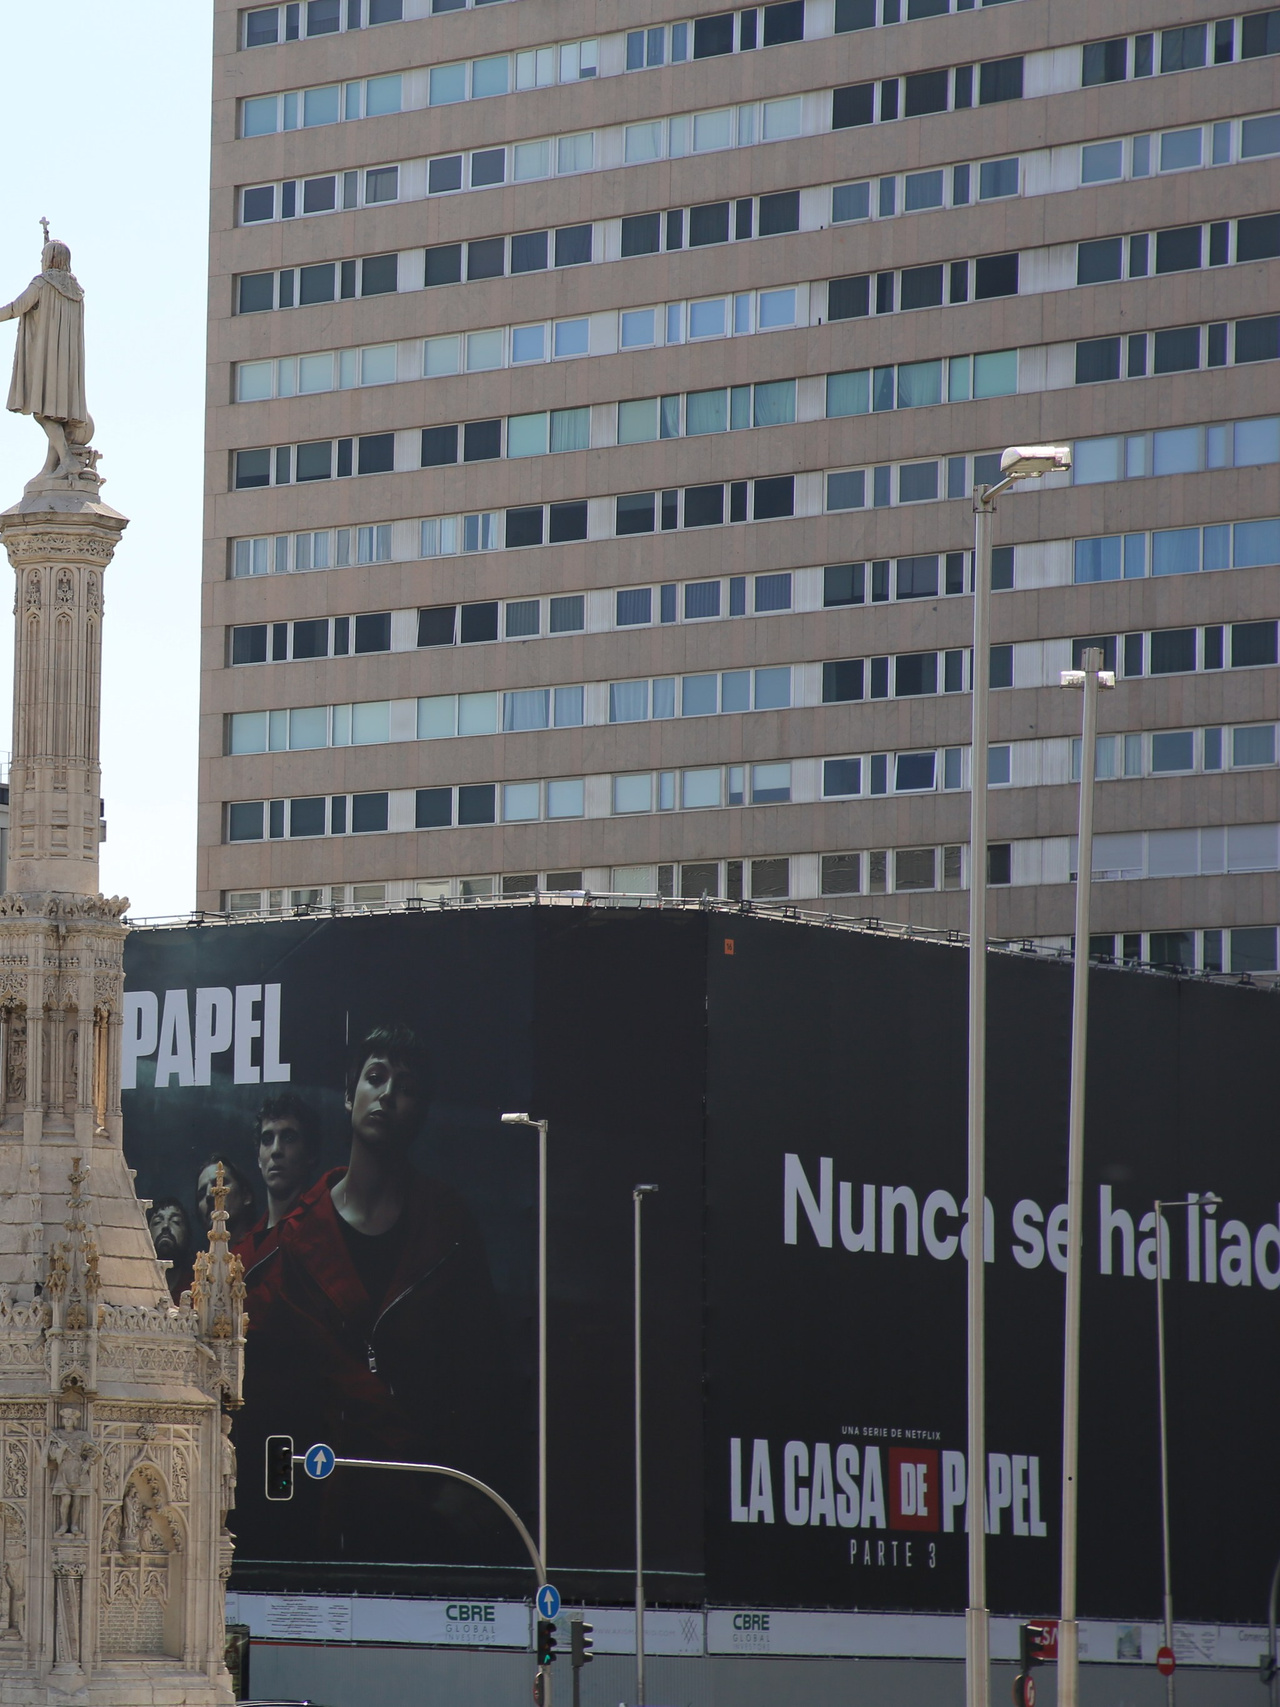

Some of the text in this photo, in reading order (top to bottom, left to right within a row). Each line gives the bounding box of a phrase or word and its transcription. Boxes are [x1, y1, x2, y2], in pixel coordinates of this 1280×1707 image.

[120, 983, 291, 1090] PAPEL
[784, 1153, 994, 1263] Nunca
[1012, 1198, 1082, 1273] se
[1099, 1184, 1170, 1280] ha
[841, 1425, 941, 1440] UNA SERIE DE NETFLIX
[730, 1437, 1047, 1537] LA CASA DE PPEL
[850, 1539, 937, 1568] PARTE 3
[446, 1604, 495, 1622] CBRE
[446, 1624, 496, 1633] GLOBAL
[733, 1614, 770, 1631] CBRE
[445, 1634, 496, 1642] INVESTORS
[733, 1633, 771, 1643] GLOBAL
